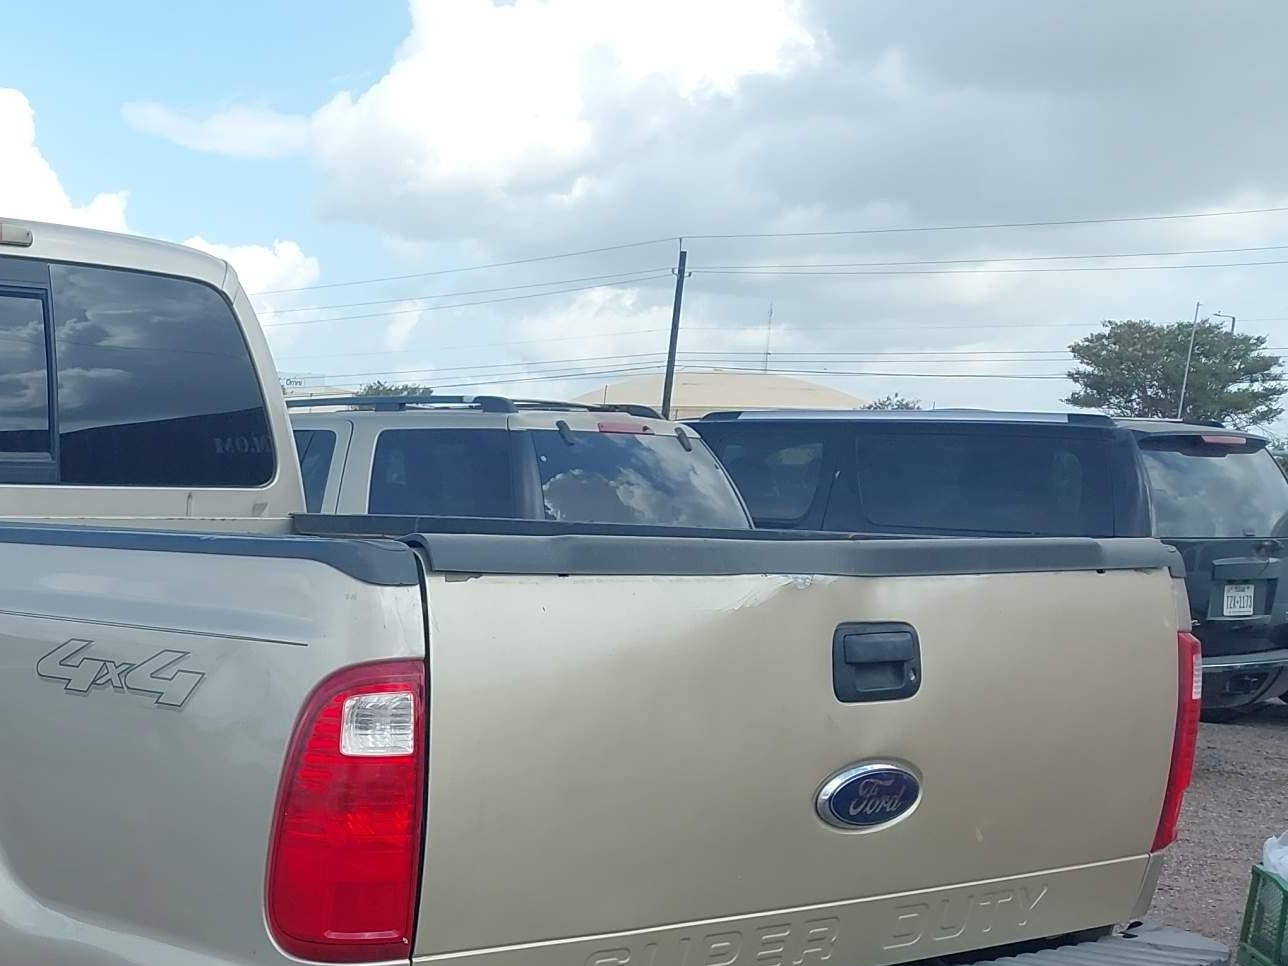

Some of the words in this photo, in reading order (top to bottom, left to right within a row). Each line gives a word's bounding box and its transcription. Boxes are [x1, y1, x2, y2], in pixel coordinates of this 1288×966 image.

[36, 638, 206, 708] 4x4
[849, 778, 907, 816] Ford
[883, 884, 1049, 950] DUTY
